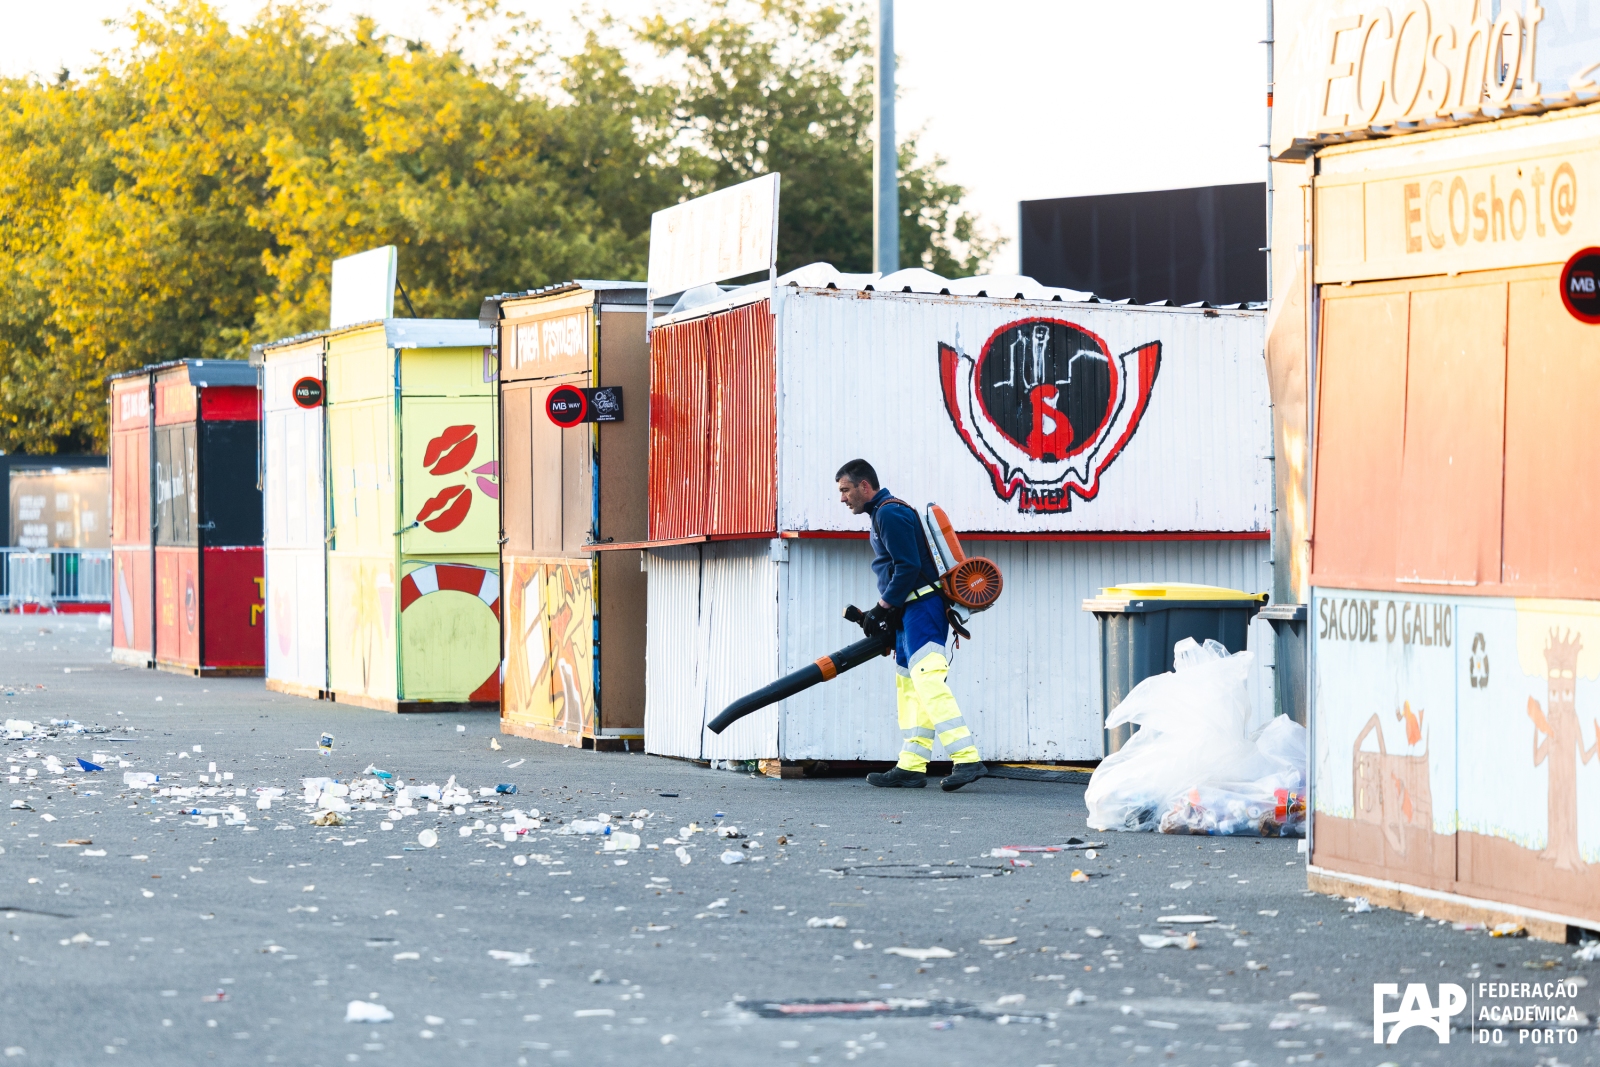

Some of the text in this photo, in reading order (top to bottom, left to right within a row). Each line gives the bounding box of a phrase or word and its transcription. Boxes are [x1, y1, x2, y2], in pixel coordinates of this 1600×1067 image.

[1570, 277, 1596, 293] MB
[552, 402, 567, 411] MB
[1023, 487, 1065, 505] TAFEP
[1320, 597, 1452, 648] SACODE O GALHO
